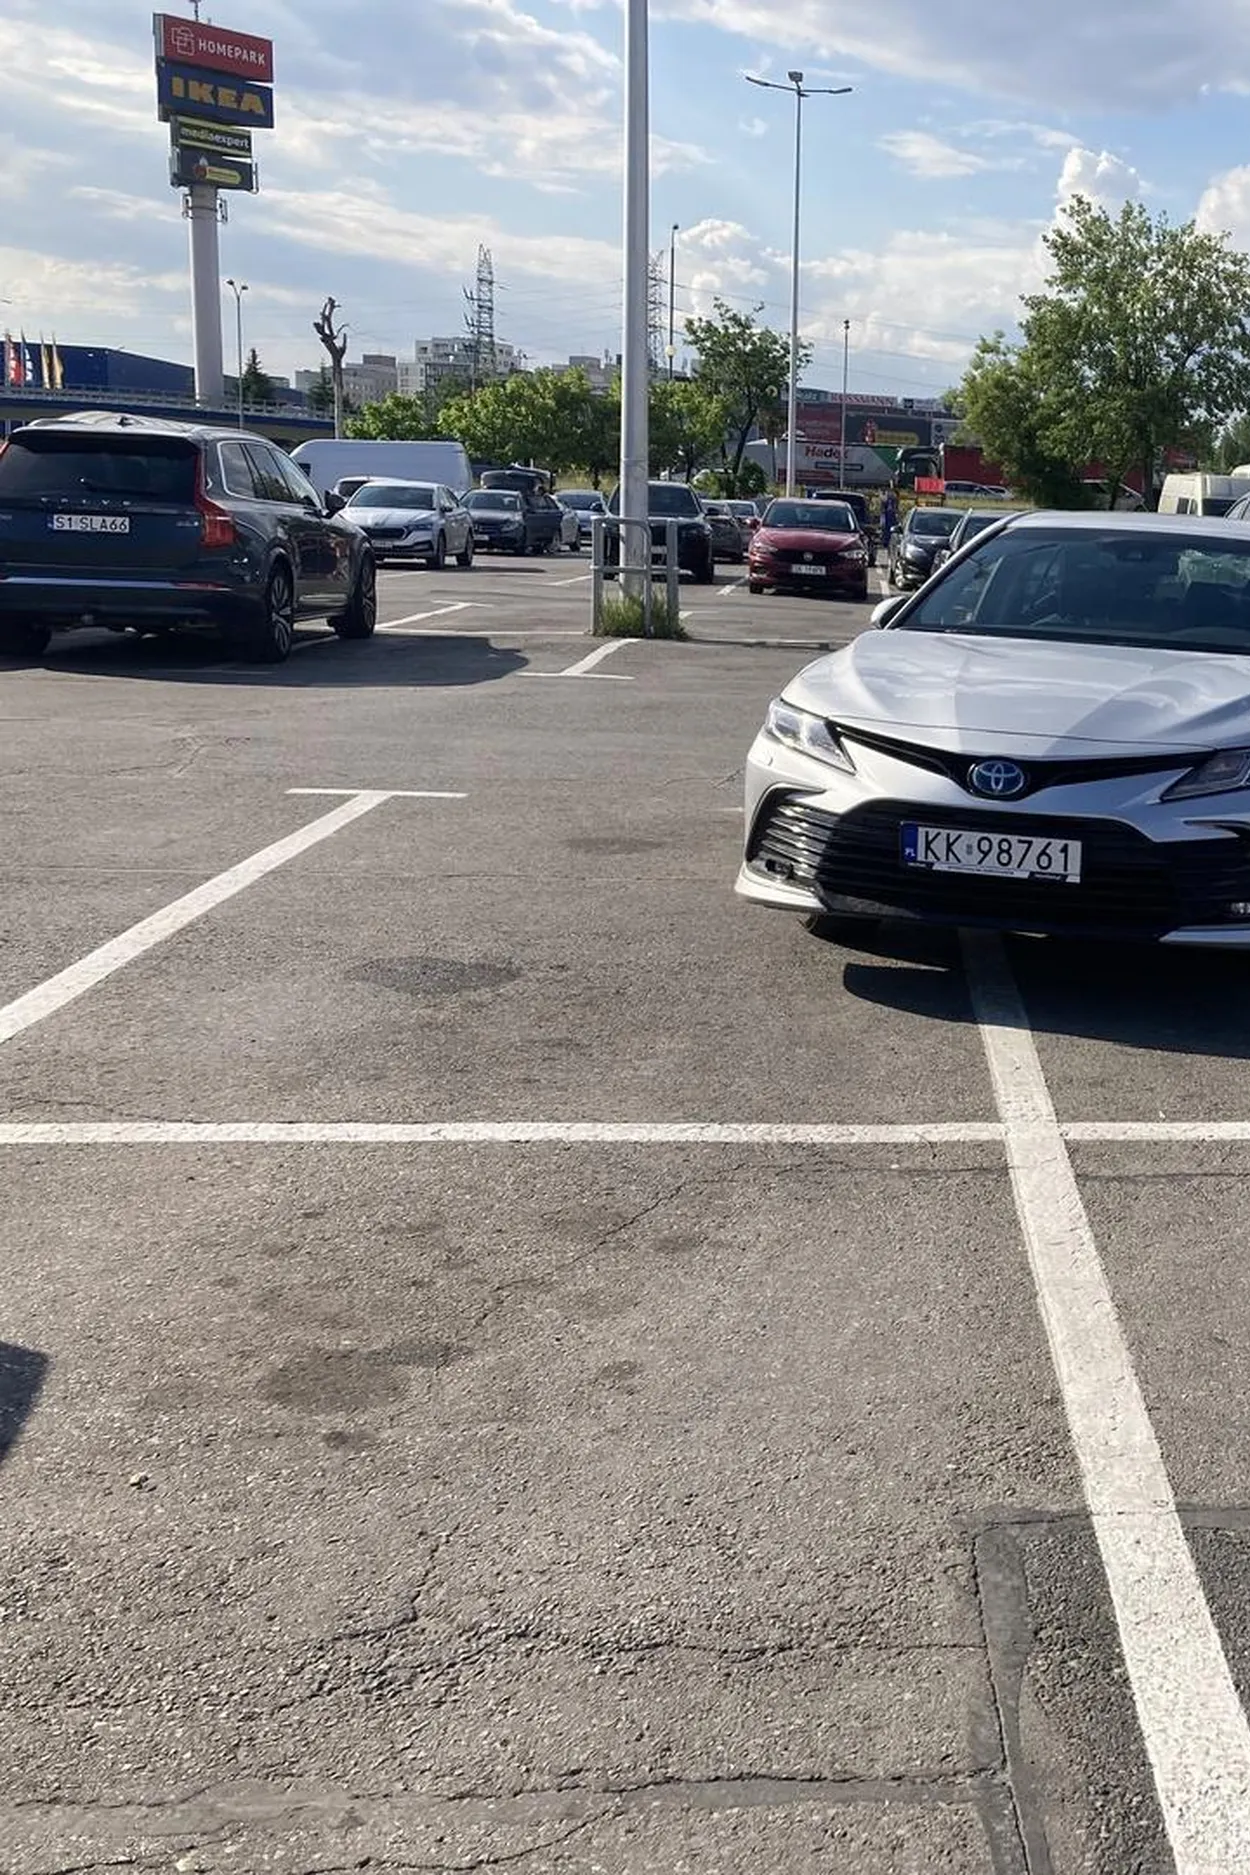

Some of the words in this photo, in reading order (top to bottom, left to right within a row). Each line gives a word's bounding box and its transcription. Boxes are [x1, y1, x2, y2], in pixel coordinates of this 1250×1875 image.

[198, 39, 266, 66] HOMEPARK
[171, 76, 266, 116] IKEA
[55, 516, 74, 529] S1
[79, 516, 128, 532] SLA66
[924, 830, 964, 864] KK
[976, 836, 1069, 873] 98761
